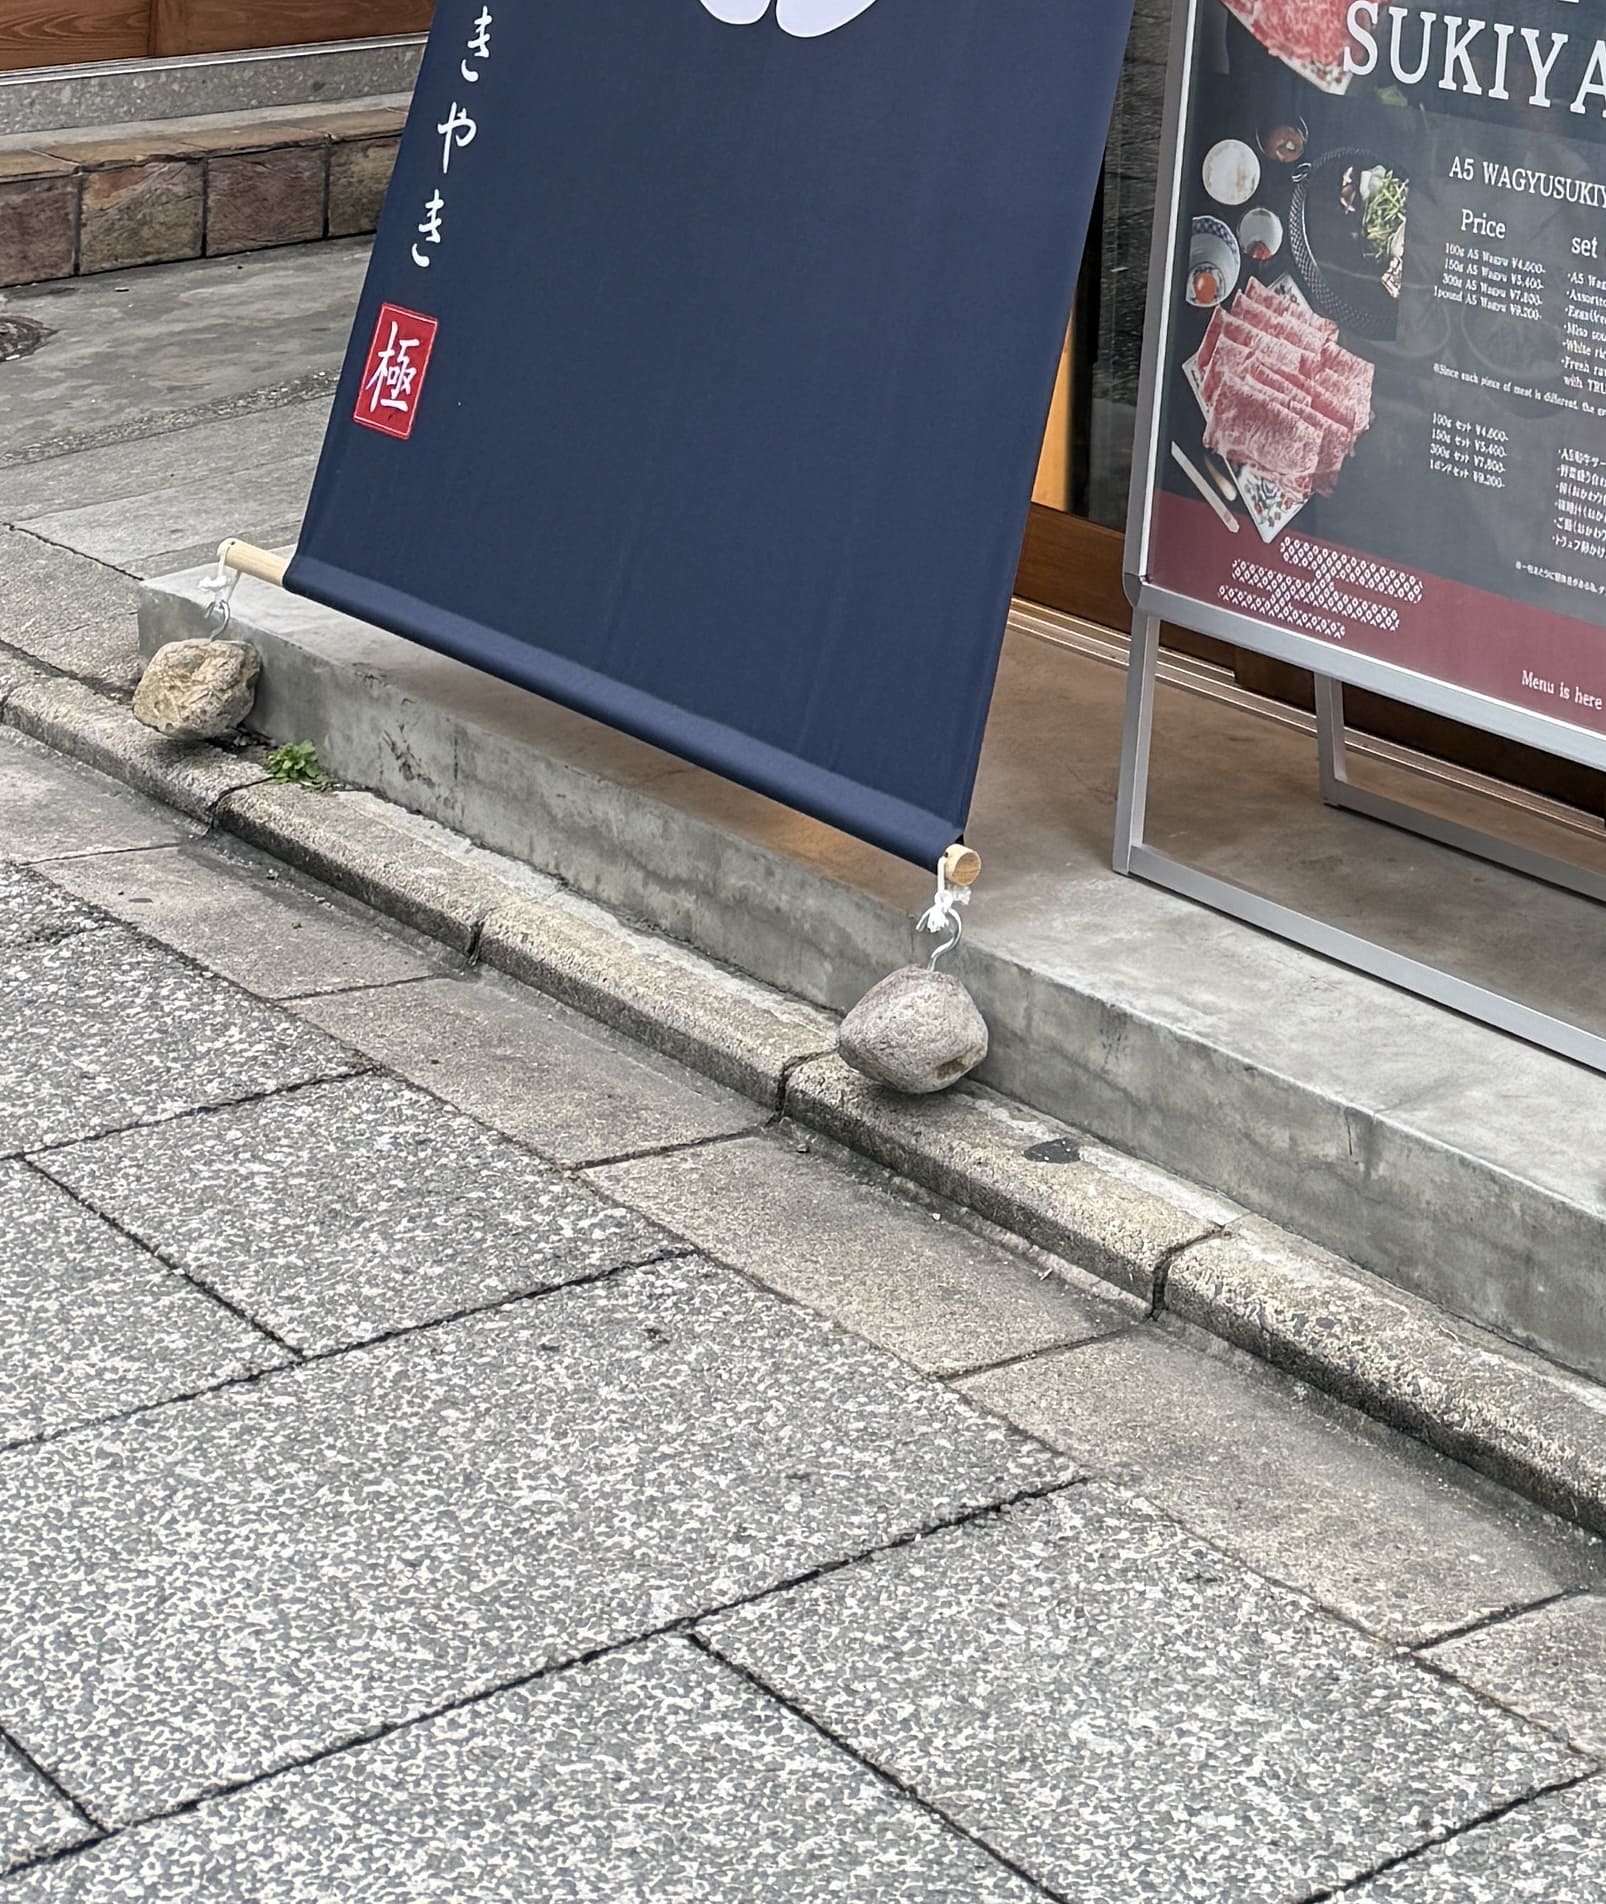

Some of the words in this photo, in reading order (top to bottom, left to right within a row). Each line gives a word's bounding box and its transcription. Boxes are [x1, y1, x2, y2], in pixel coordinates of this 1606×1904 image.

[1450, 156, 1474, 181] A5
[1461, 208, 1506, 239] Price
[1467, 248, 1480, 260] A5
[1571, 237, 1598, 258] set
[1466, 263, 1479, 275] A5
[1465, 279, 1478, 291] A5
[1465, 293, 1478, 305] A5
[366, 321, 421, 412] 極
[1521, 670, 1555, 694] Menu
[1560, 682, 1570, 700] is
[1575, 686, 1603, 711] here
